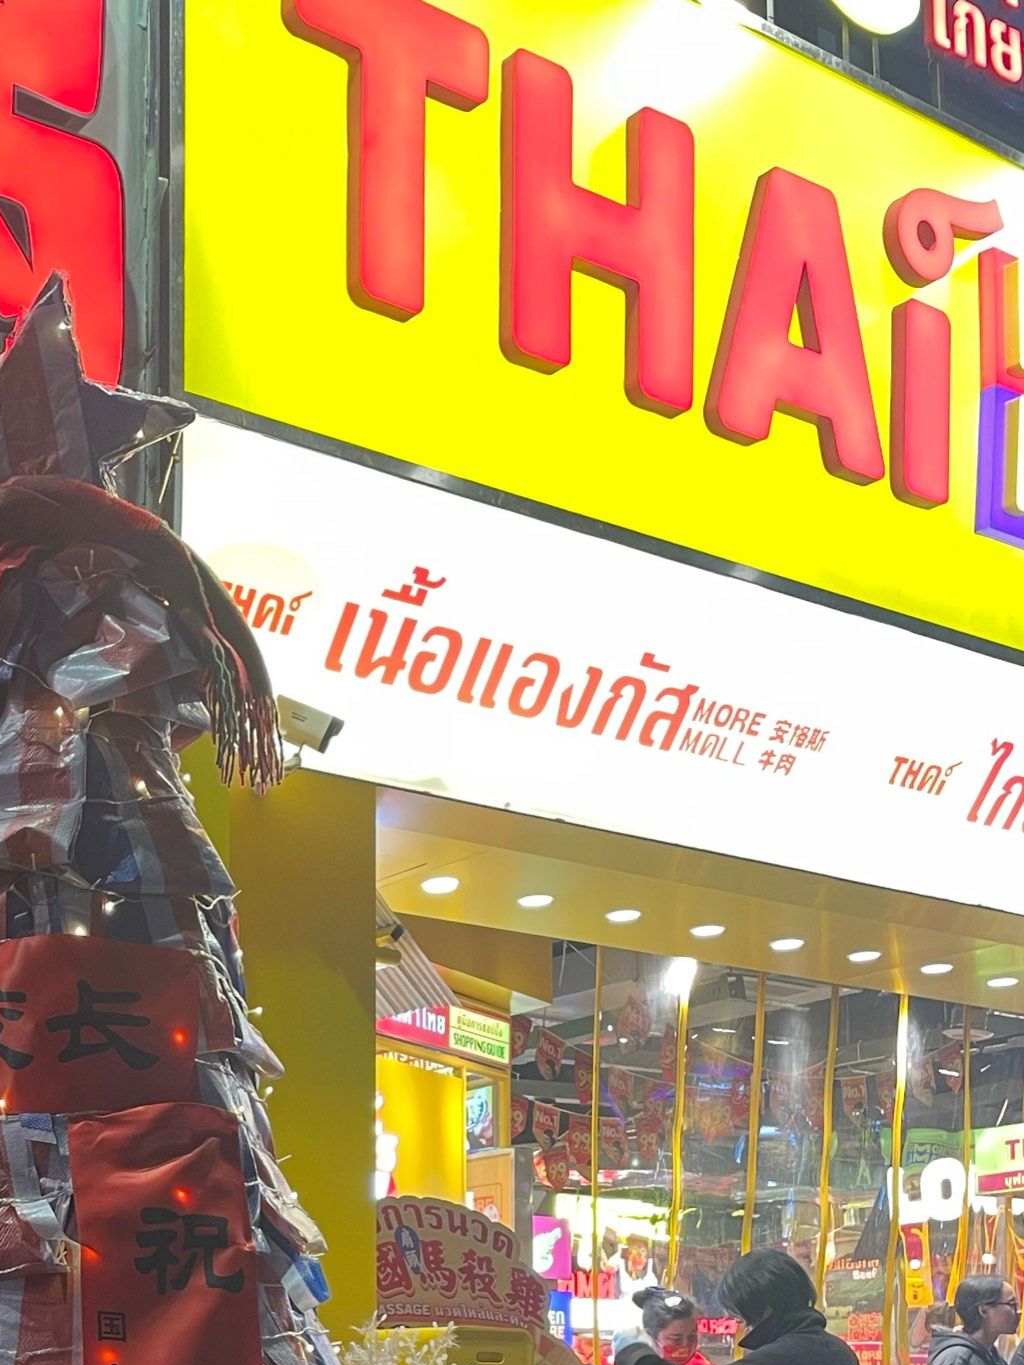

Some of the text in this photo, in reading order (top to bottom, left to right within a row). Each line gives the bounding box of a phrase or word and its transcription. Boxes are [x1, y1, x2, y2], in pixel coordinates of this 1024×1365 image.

[691, 697, 831, 752] MORE 安格斯
[757, 749, 797, 776] 牛肉
[539, 1036, 562, 1058] No.1
[843, 1083, 866, 1098] No.1
[535, 1109, 558, 1127] No.1
[376, 1204, 514, 1260] การนวด
[377, 1303, 430, 1317] ASSAGE
